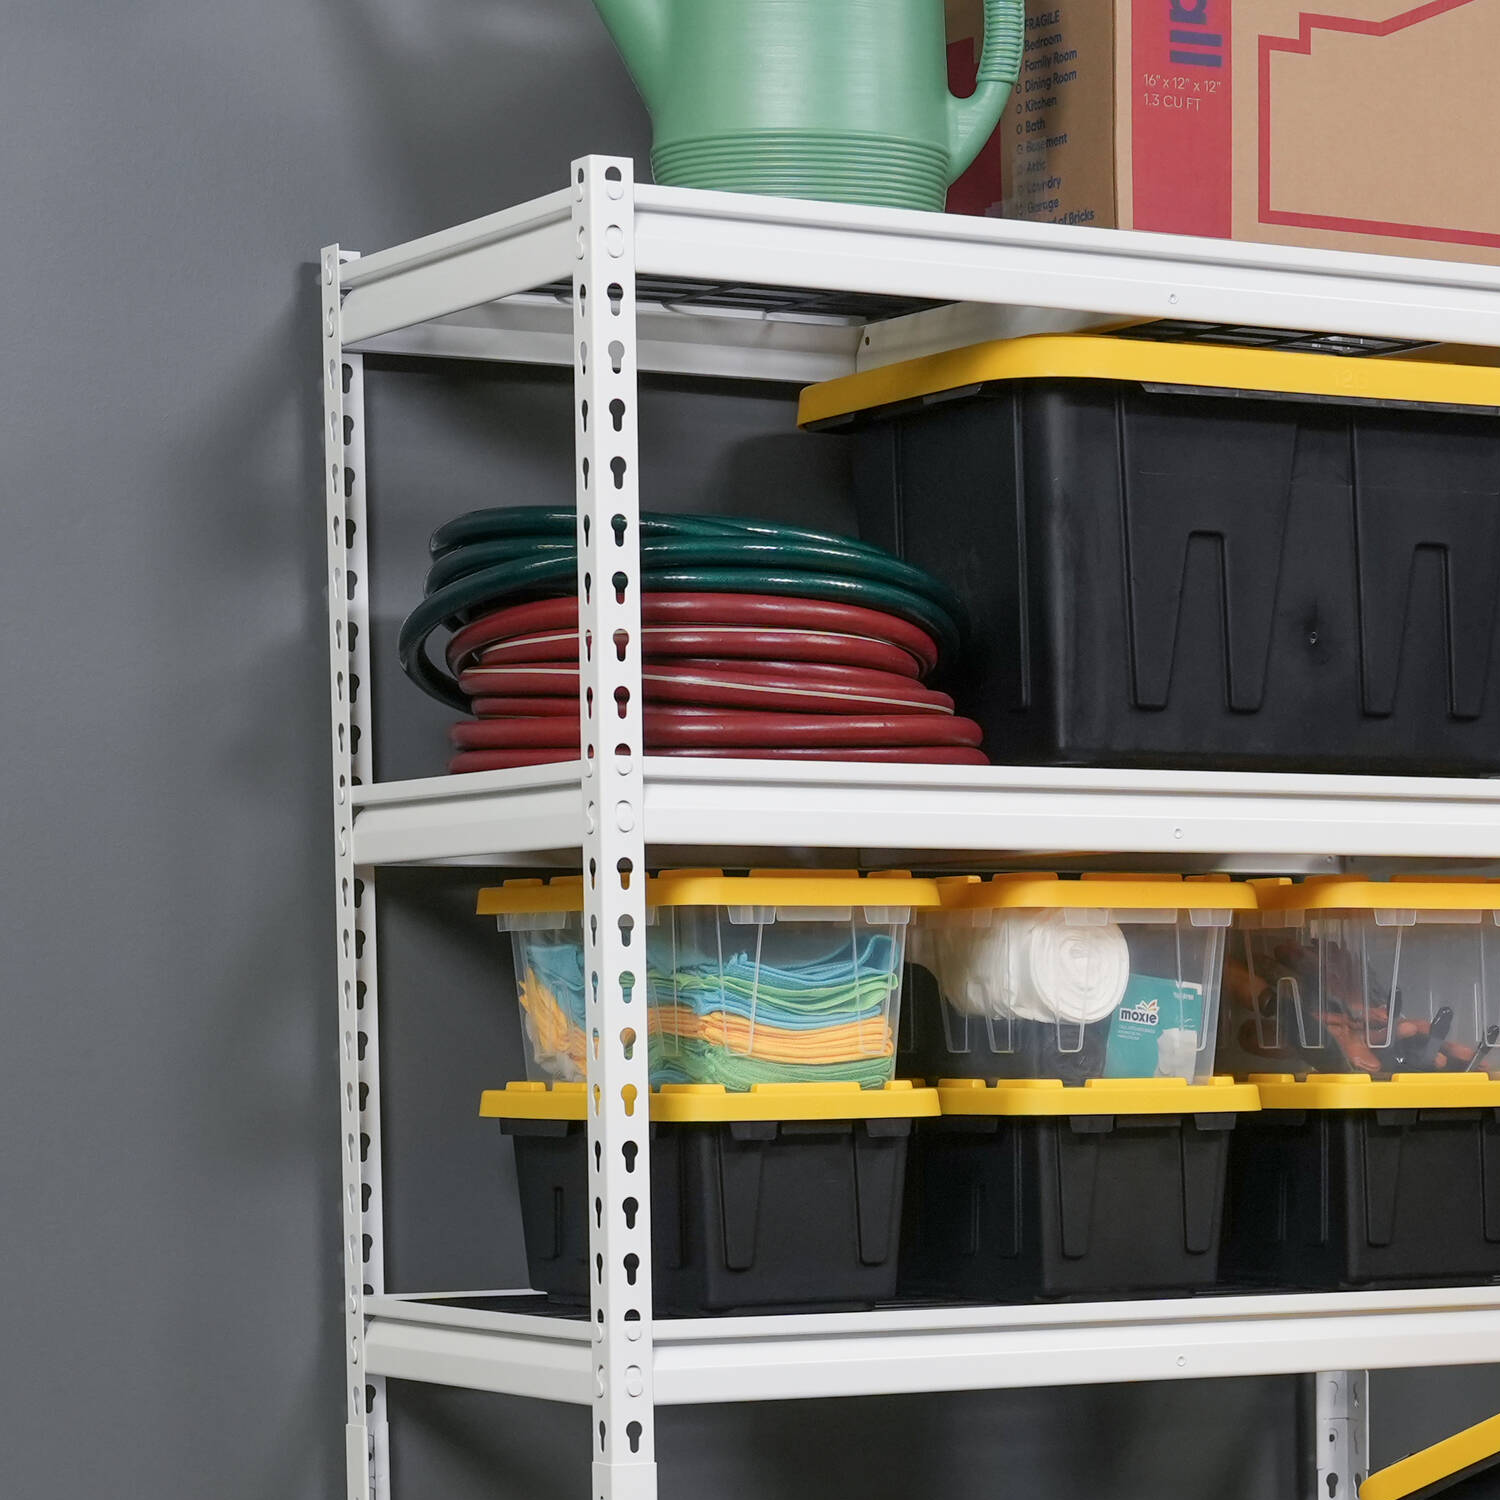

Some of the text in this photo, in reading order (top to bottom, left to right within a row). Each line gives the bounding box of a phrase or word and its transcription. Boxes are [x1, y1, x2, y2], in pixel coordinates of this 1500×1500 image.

[1025, 10, 1060, 30] FRAGILE
[1025, 33, 1062, 52] Bedroom
[1025, 49, 1078, 71] Family Room
[1025, 70, 1077, 92] Dining Room
[1143, 72, 1221, 93] 16" x 12" x 12"
[1025, 97, 1057, 113] Kitchen
[1143, 92, 1201, 112] 1.3 CU FT
[1025, 118, 1046, 133] Bath
[1068, 208, 1095, 225] Bricks
[1120, 1009, 1158, 1025] moxie
